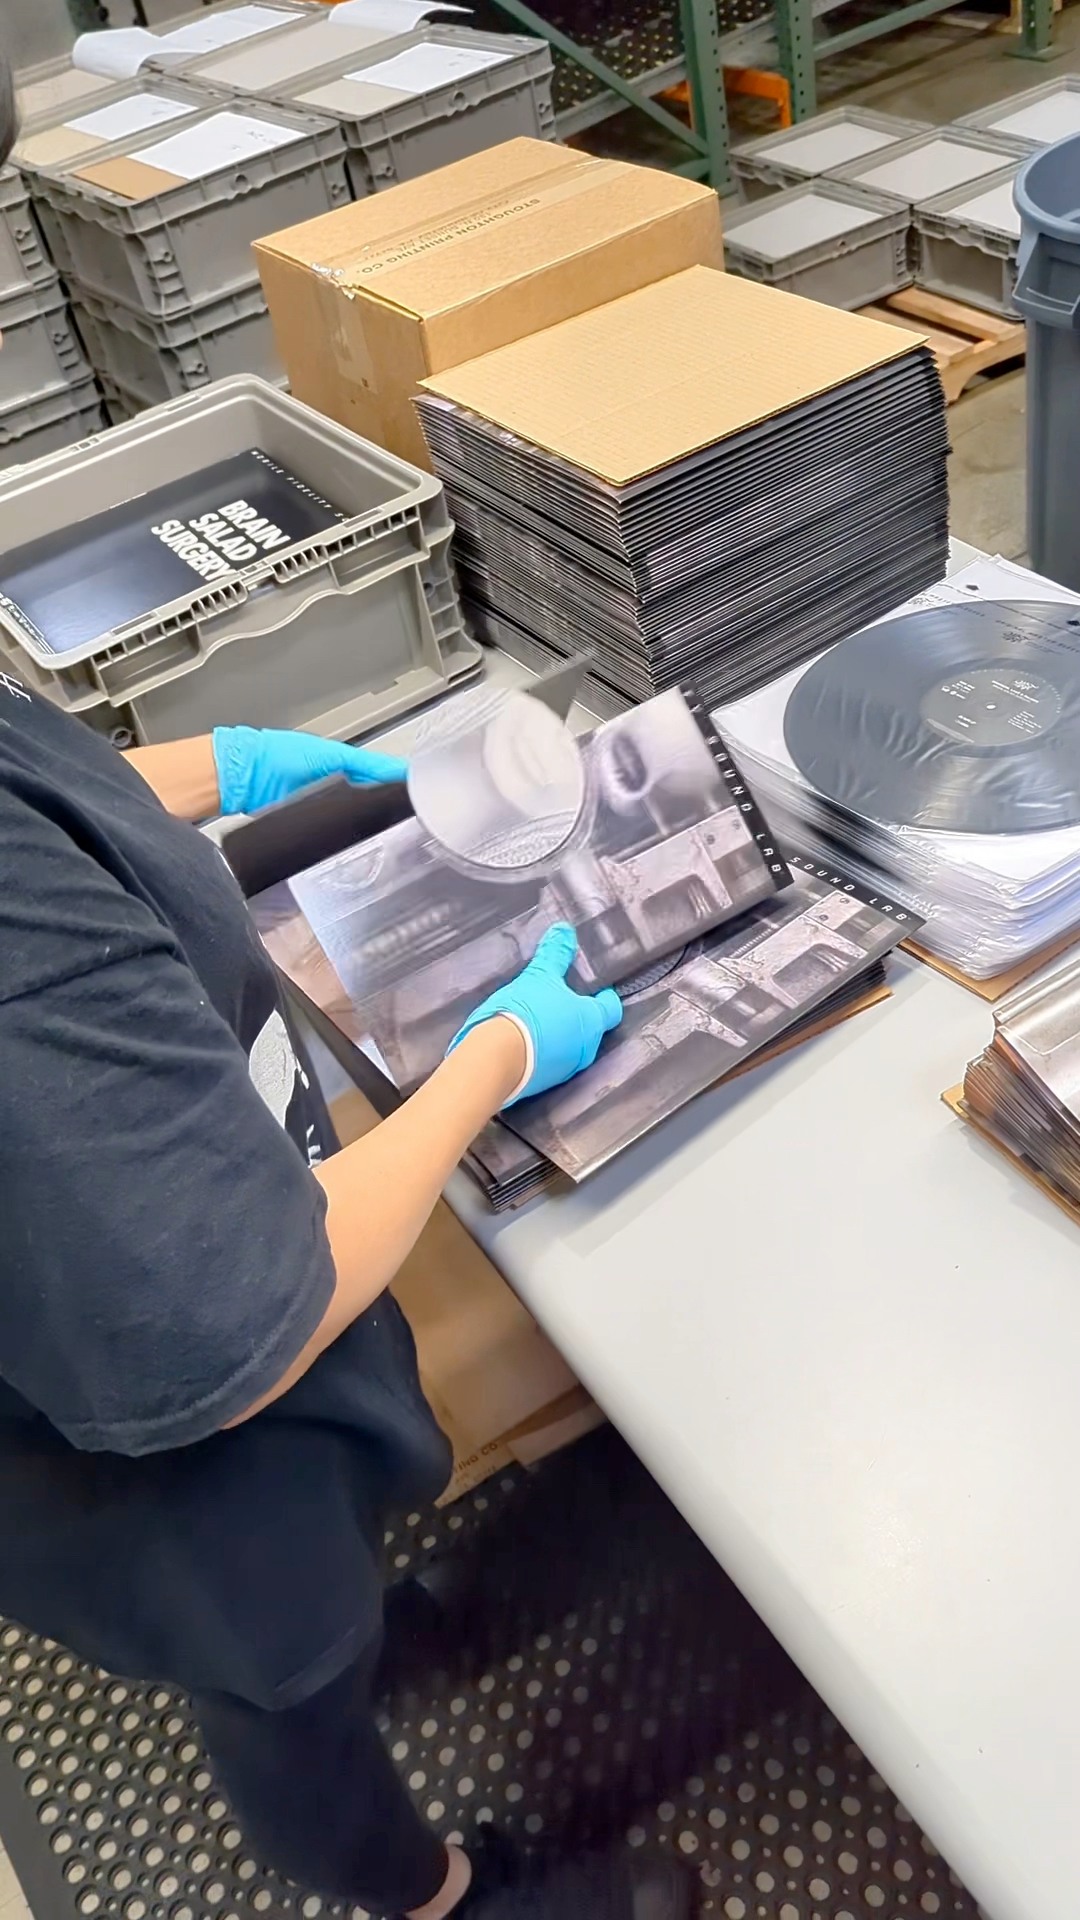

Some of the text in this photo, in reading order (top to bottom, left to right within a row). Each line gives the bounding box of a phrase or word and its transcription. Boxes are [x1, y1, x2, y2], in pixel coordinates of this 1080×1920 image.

[456, 198, 541, 236] STOUGHTON
[357, 262, 384, 275] CO.
[386, 235, 454, 263] PRINTING
[250, 449, 285, 474] MOBILE
[286, 475, 333, 508] FIDELITY
[150, 519, 239, 581] SURGERY
[189, 512, 257, 561] SALAD
[217, 499, 291, 550] BRAIN
[706, 735, 783, 873] SOUND LAB
[788, 855, 908, 921] SOUND LAB
